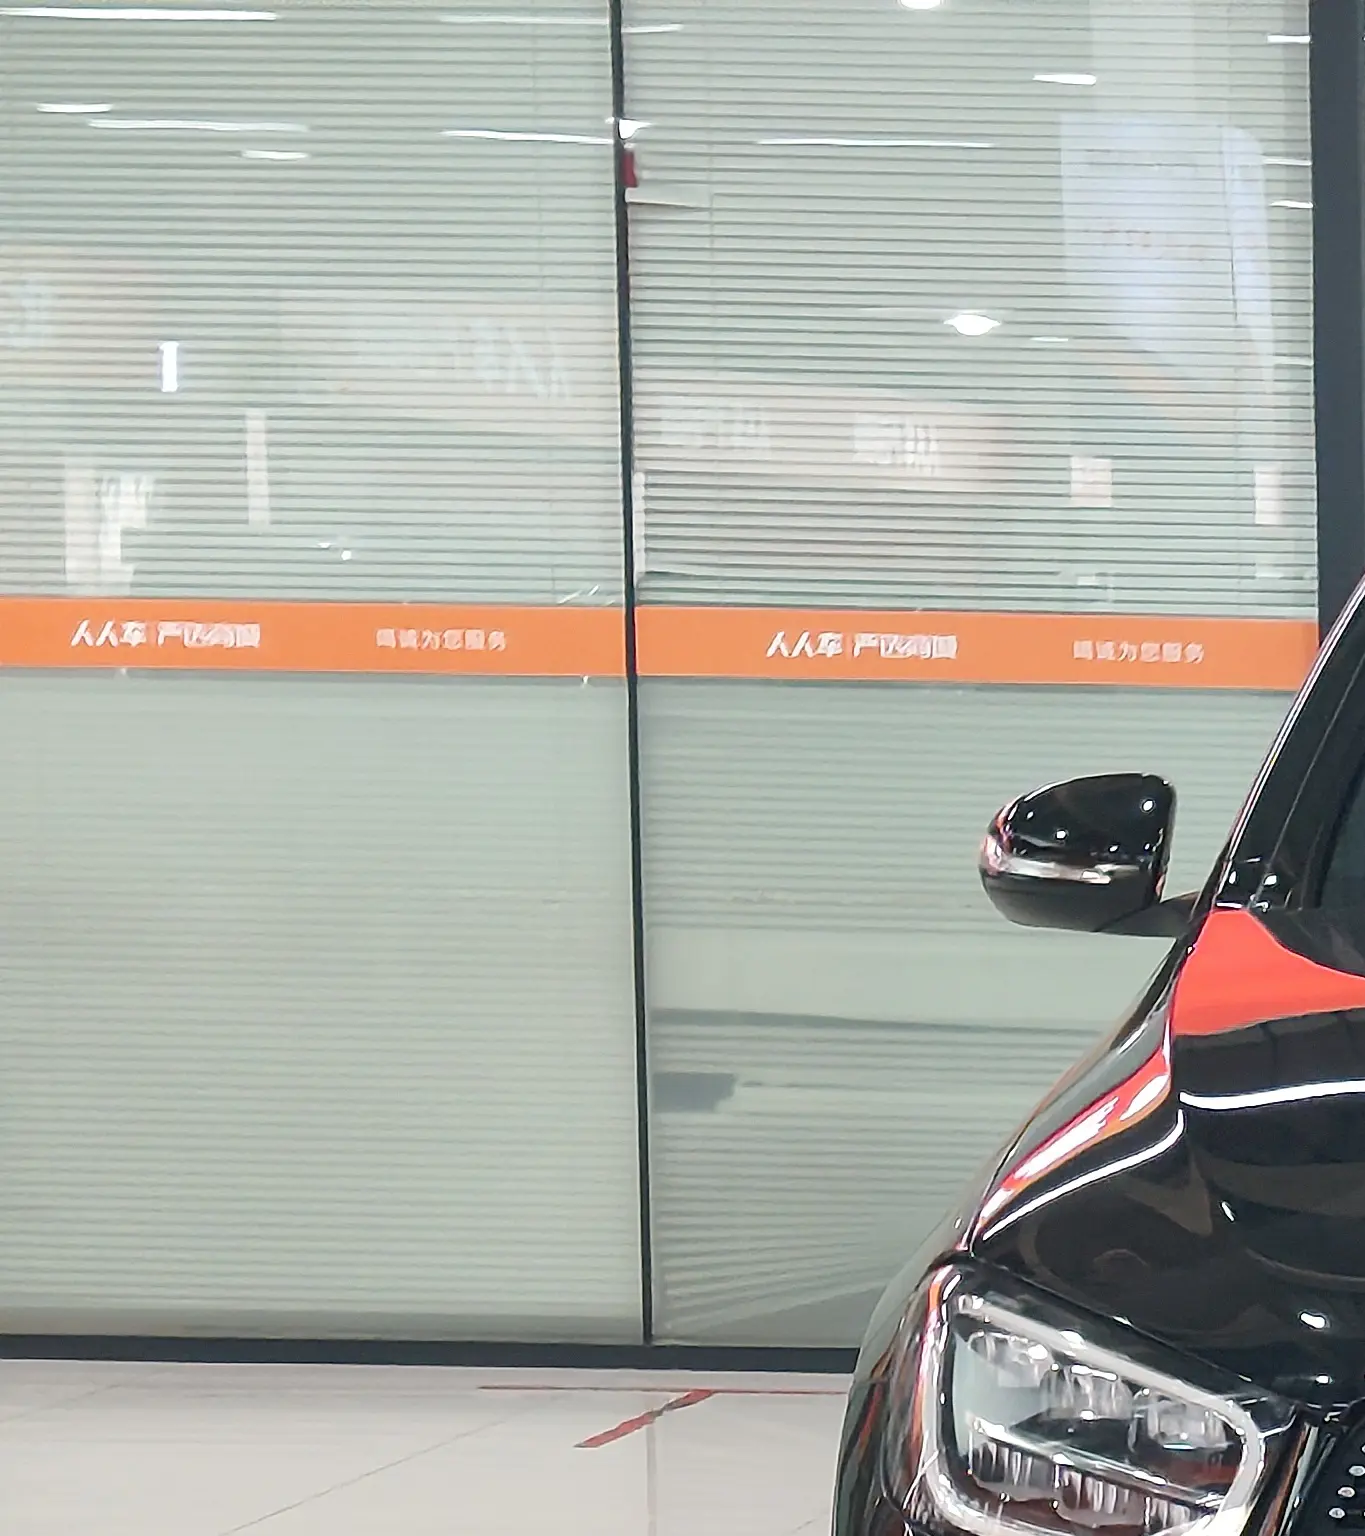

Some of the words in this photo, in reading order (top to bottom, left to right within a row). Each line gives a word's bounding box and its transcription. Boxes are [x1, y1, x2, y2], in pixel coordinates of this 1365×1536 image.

[70, 619, 148, 647] 人人车
[765, 630, 844, 658] 人人车
